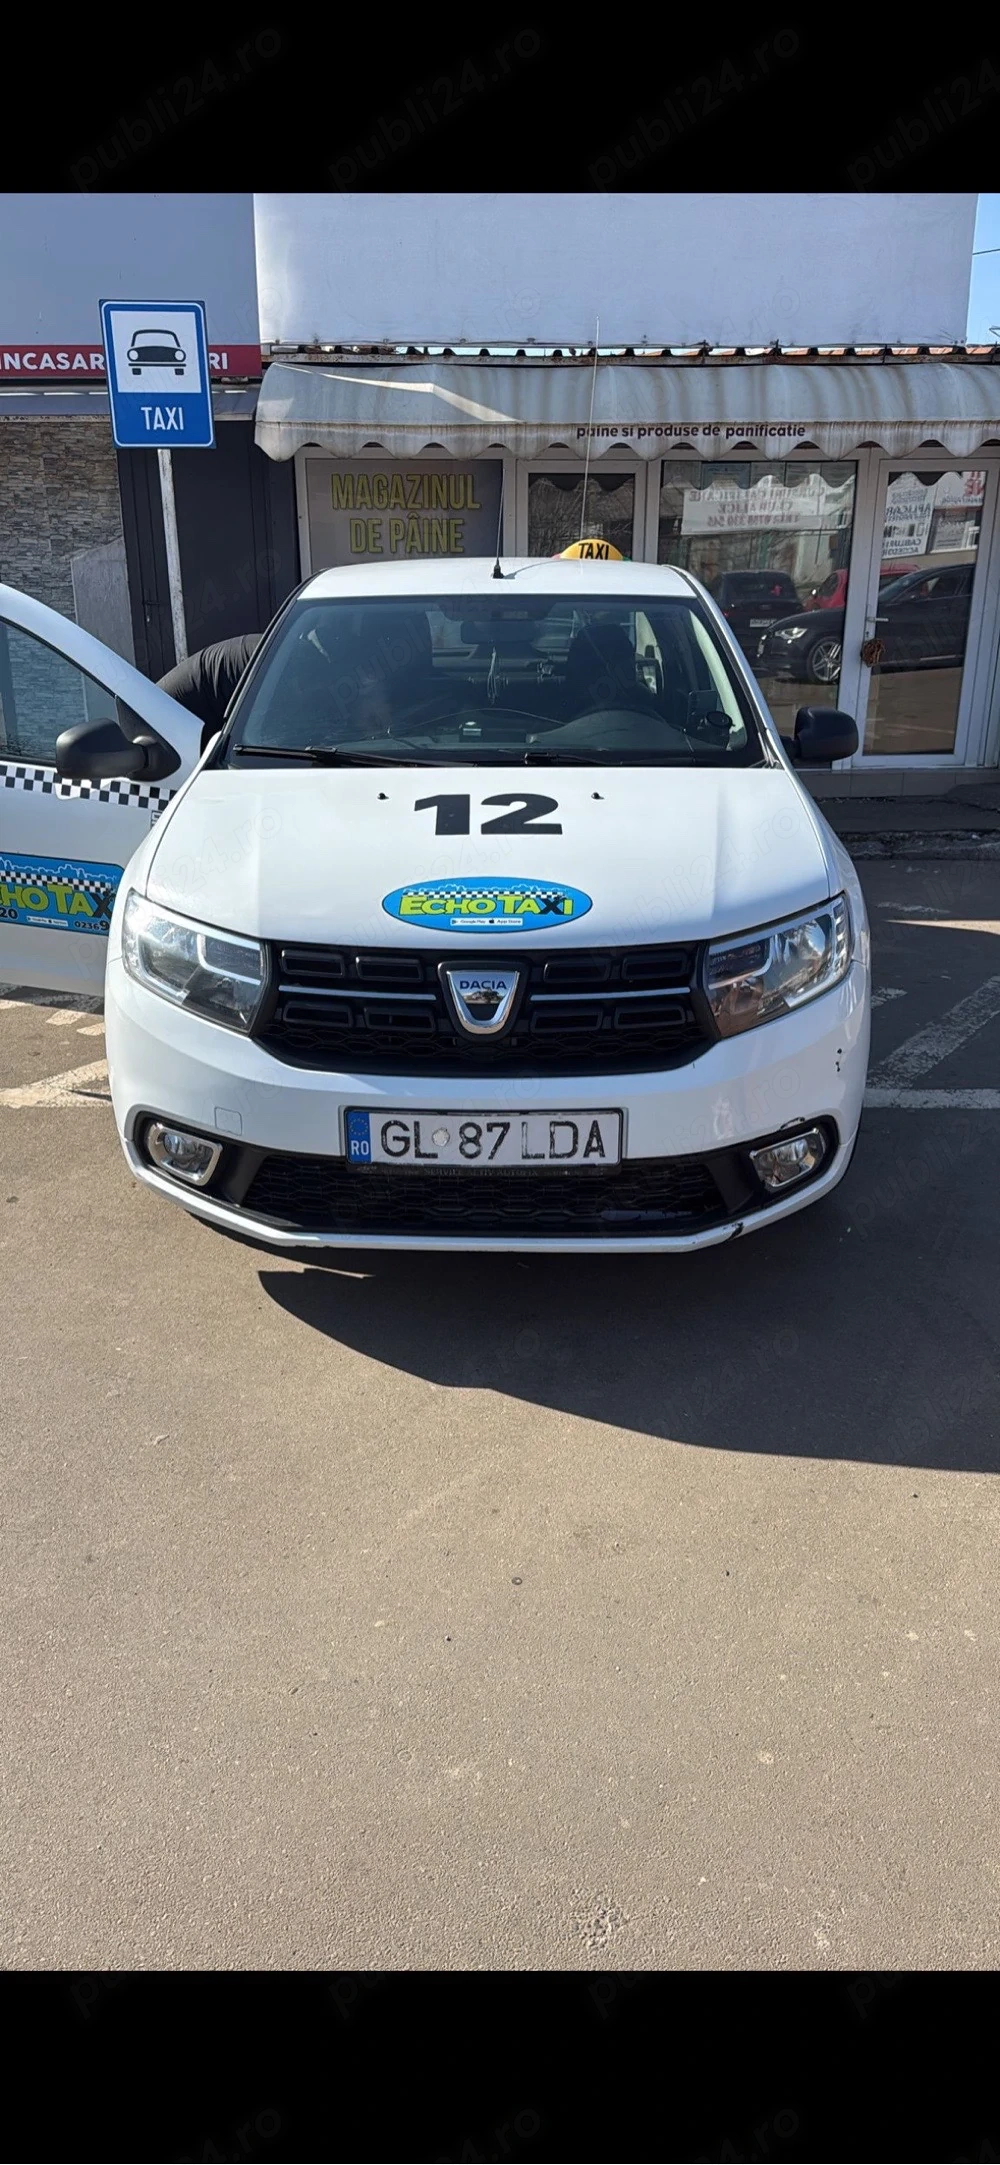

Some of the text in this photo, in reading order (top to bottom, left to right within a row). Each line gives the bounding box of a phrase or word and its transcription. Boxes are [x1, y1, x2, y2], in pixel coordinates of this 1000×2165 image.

[0, 352, 104, 370] NCASAR
[140, 406, 184, 430] TAXI
[576, 423, 806, 439] paine si produse de panificatie
[332, 473, 482, 510] MAGAZINUL
[350, 511, 465, 554] DE PÂINE
[578, 542, 609, 560] TAXI
[414, 792, 563, 836] 12
[460, 980, 507, 990] DACIA
[351, 1140, 369, 1156] RO
[381, 1119, 606, 1160] GL 87 LDA
